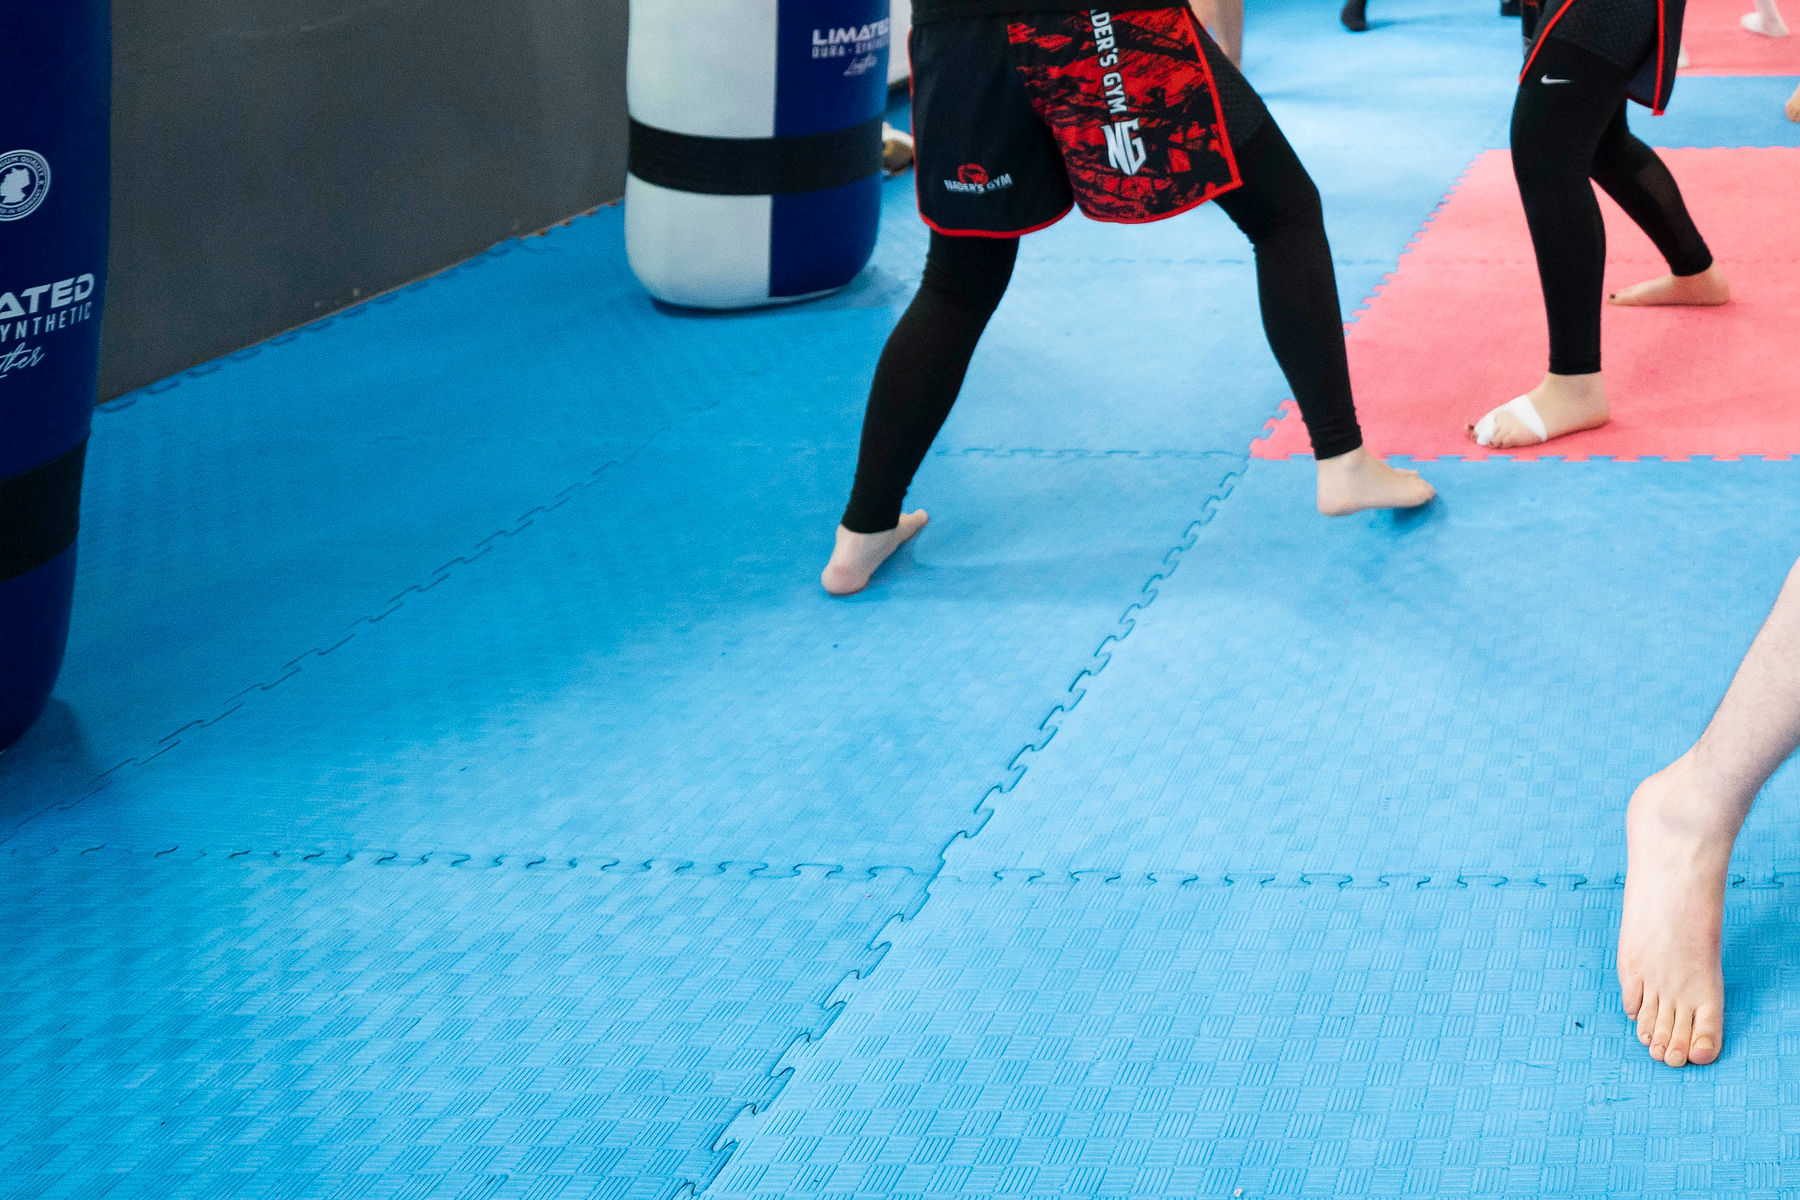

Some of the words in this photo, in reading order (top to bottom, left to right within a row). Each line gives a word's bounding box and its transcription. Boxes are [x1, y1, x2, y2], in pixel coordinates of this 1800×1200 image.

[1090, 8, 1119, 68] DER'S
[1102, 71, 1128, 114] GYM
[986, 172, 1012, 191] GYM
